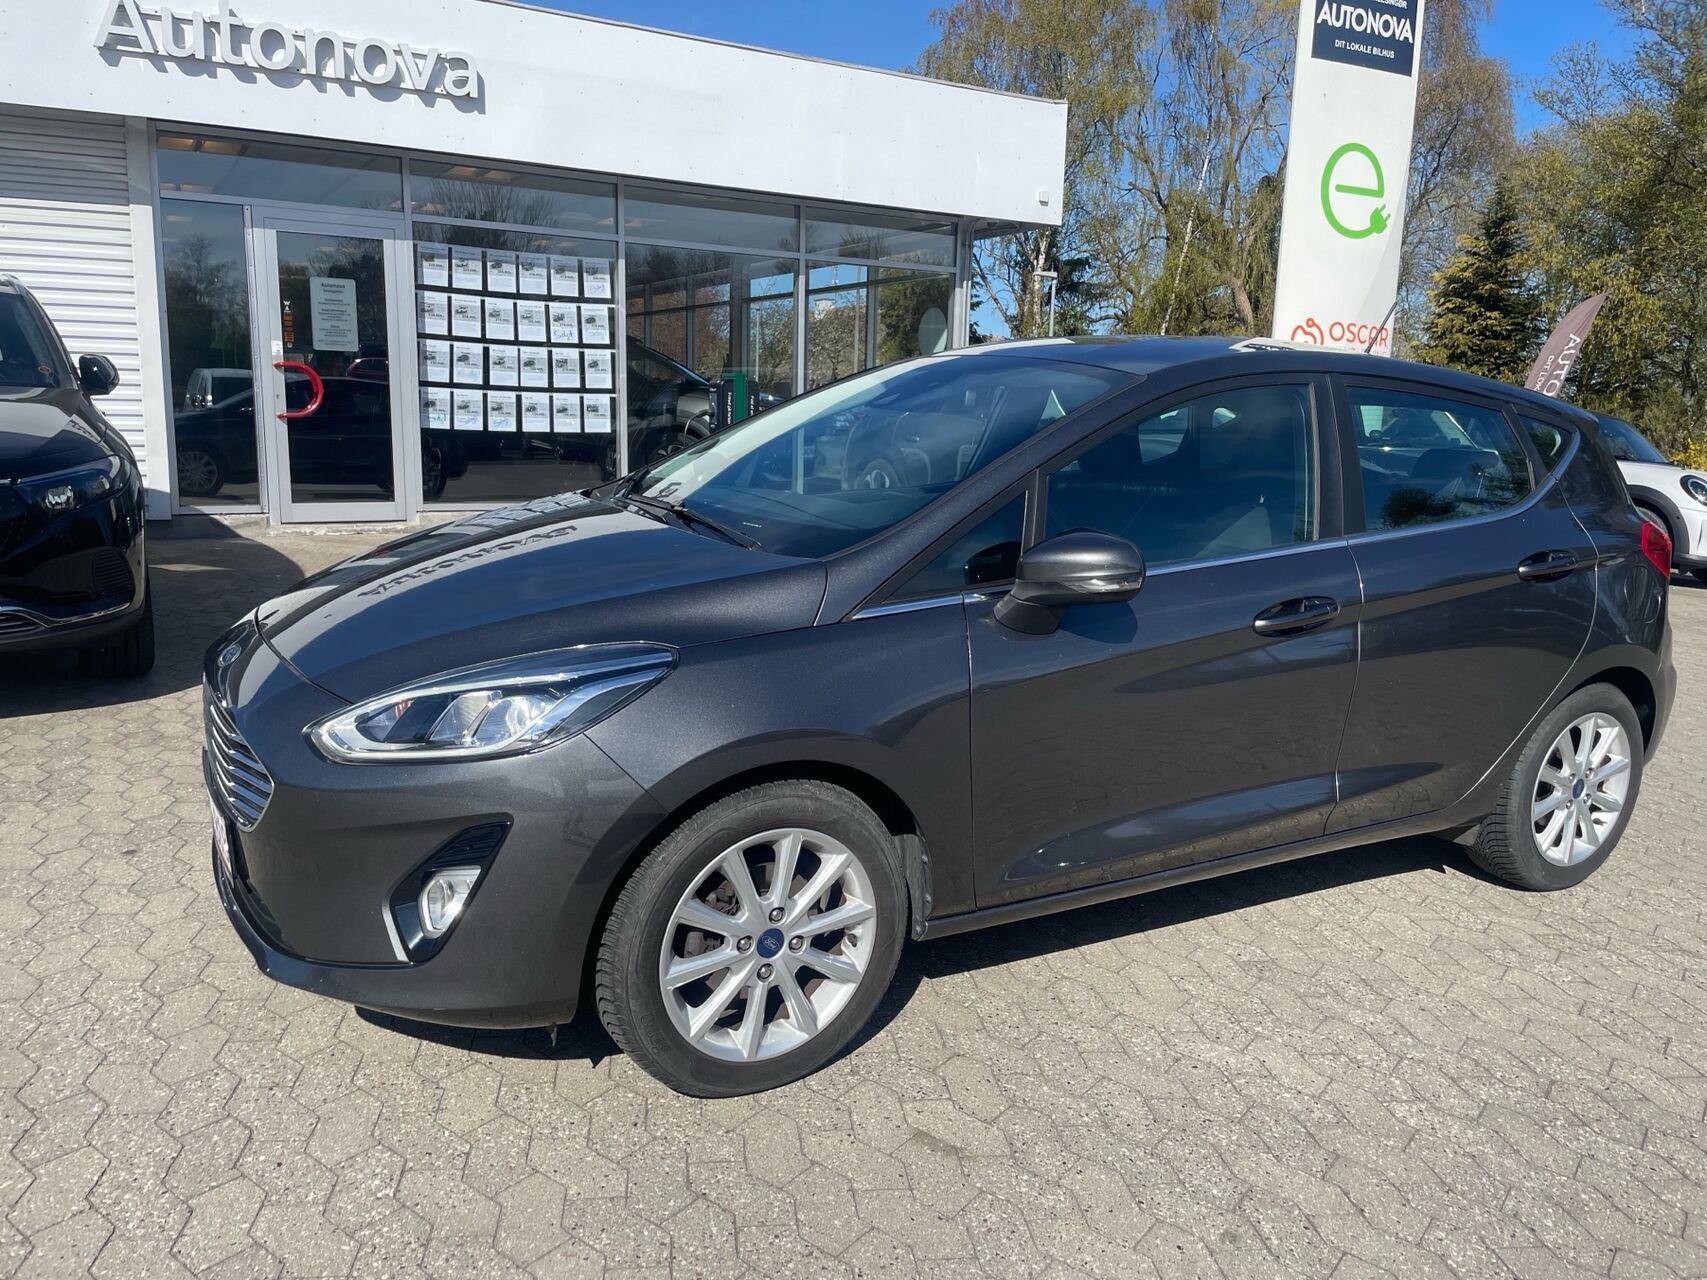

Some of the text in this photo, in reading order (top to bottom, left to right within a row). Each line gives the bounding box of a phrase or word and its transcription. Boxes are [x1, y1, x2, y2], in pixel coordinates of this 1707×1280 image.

[1316, 0, 1414, 43] AUTONOVA
[94, 0, 479, 98] Autonova
[1334, 39, 1395, 59] DIT LOKALE BILHUS
[1329, 321, 1389, 347] OSCAR
[1543, 333, 1581, 396] AUTO
